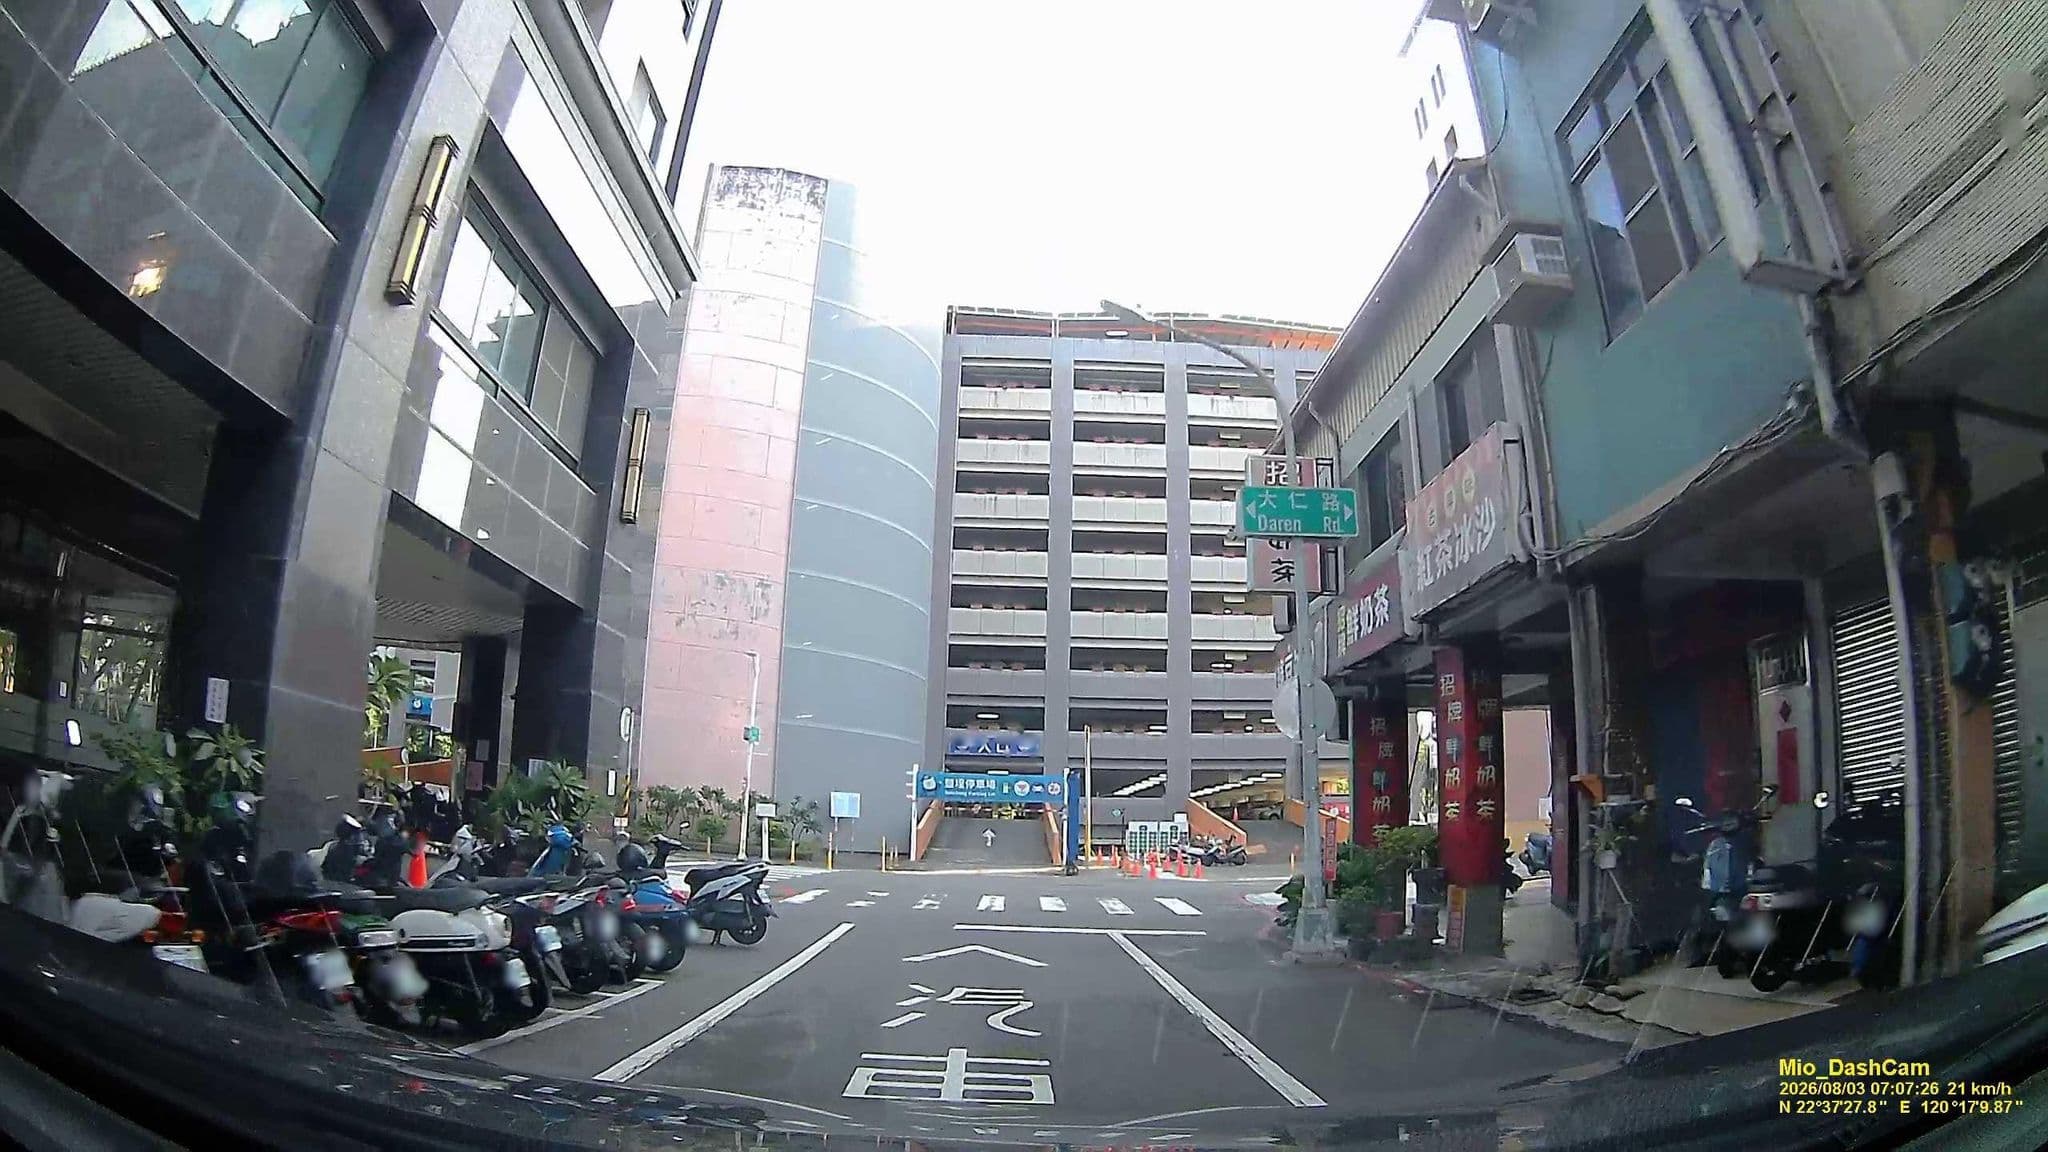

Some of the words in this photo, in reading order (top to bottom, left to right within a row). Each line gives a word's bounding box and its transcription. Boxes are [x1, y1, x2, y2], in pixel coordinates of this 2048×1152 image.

[1258, 489, 1340, 512] 大仁路
[1258, 514, 1302, 532] Daren
[1417, 496, 1496, 592] 紅茶冰沙
